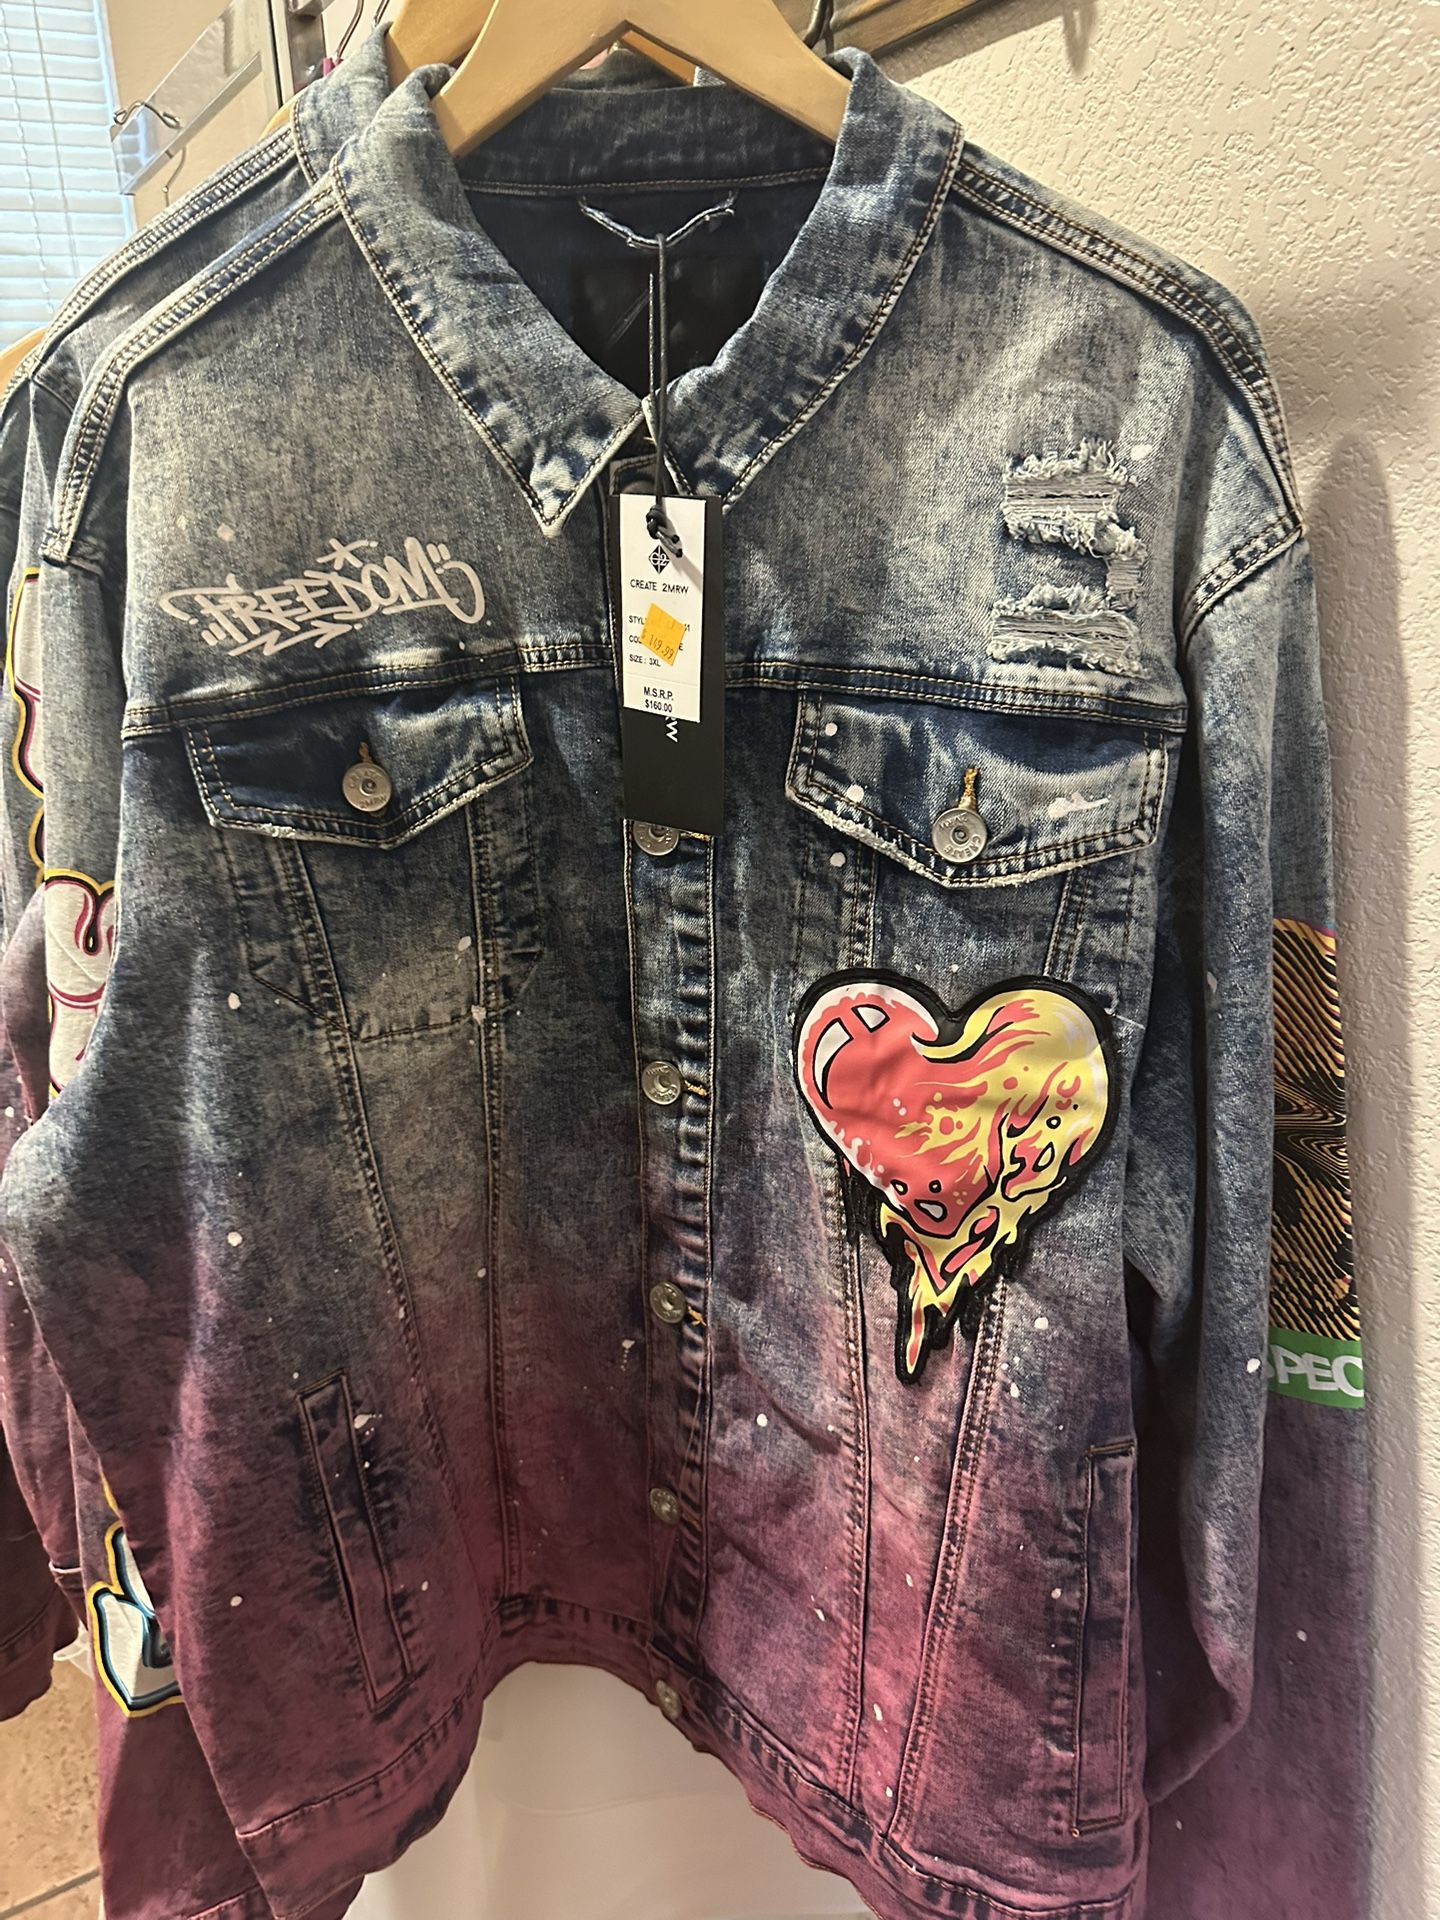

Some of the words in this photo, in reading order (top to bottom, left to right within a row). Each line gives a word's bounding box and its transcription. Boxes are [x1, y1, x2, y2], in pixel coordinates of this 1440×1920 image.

[630, 579, 657, 591] CREATE
[662, 583, 689, 594] 2MRW
[628, 615, 647, 625] STYL
[643, 686, 674, 701] M.S.R.P.
[645, 699, 673, 713] $160.00
